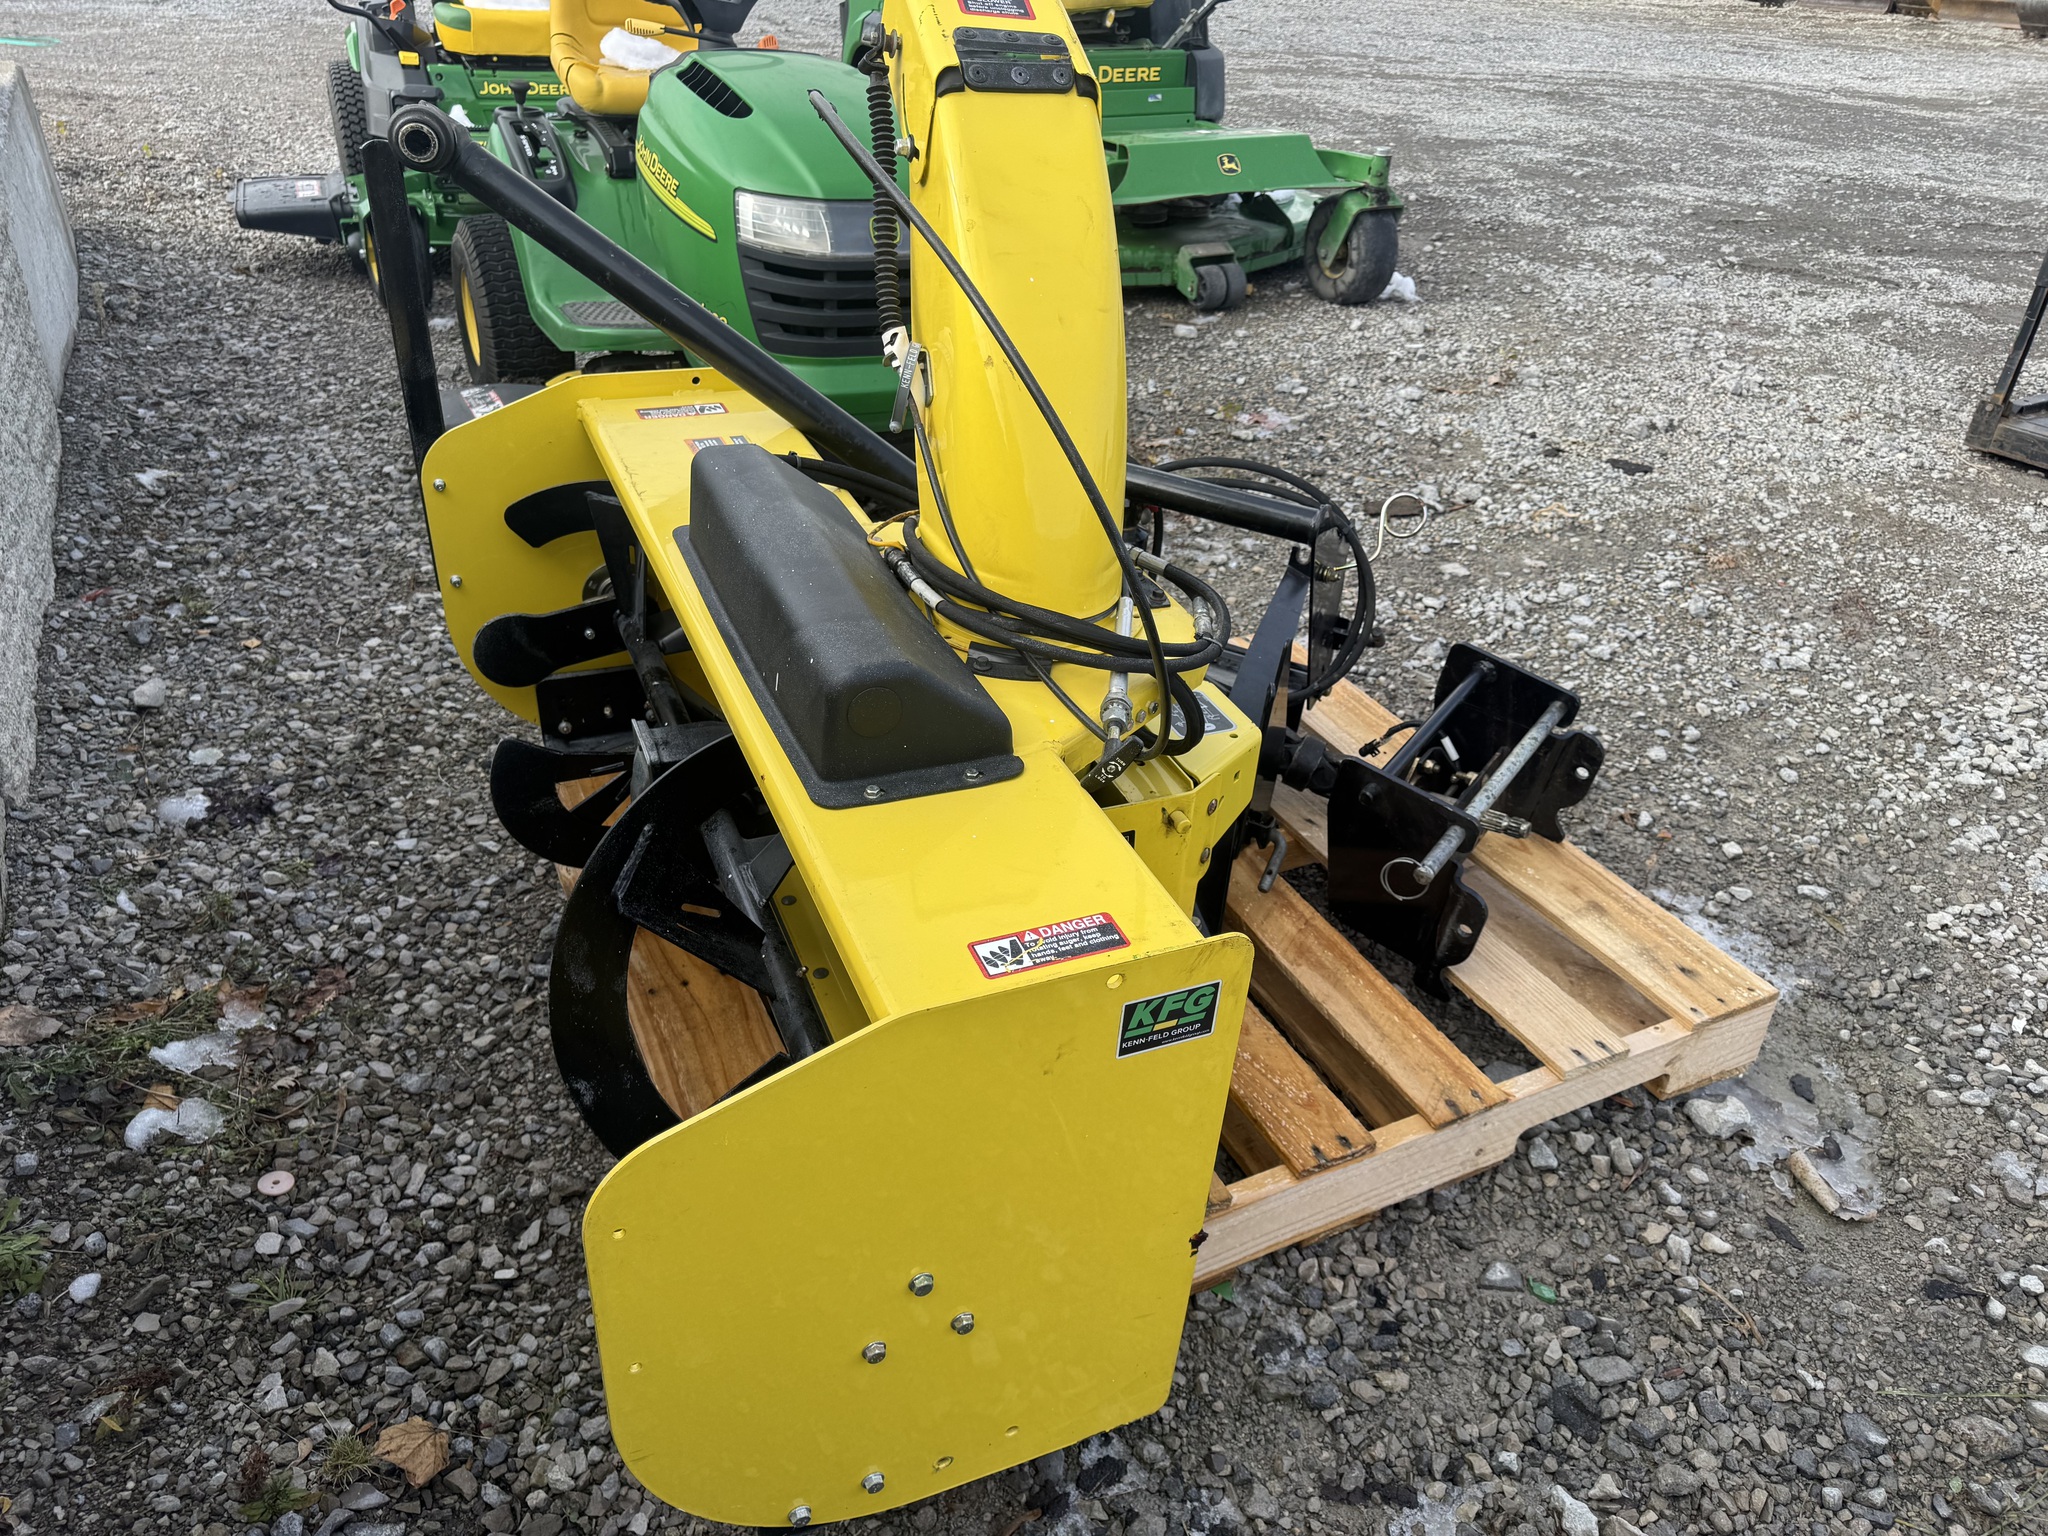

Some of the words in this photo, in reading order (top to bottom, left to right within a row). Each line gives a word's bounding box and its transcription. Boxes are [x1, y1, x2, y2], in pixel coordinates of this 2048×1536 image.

[1098, 65, 1161, 83] DEERE
[479, 81, 513, 95] JOH
[527, 82, 570, 95] DEER
[649, 152, 680, 197] DEERE
[900, 348, 918, 388] KENN-FELD
[1040, 914, 1107, 937] DANGER
[1058, 931, 1080, 942] injury
[1080, 927, 1098, 935] from
[1083, 932, 1101, 941] keep
[1060, 945, 1073, 954] feet
[1075, 940, 1088, 949] and
[1089, 933, 1120, 946] clothing
[1128, 986, 1215, 1029] KFG
[1122, 1032, 1169, 1048] KENN-FELD
[1171, 1023, 1201, 1036] GROUP
